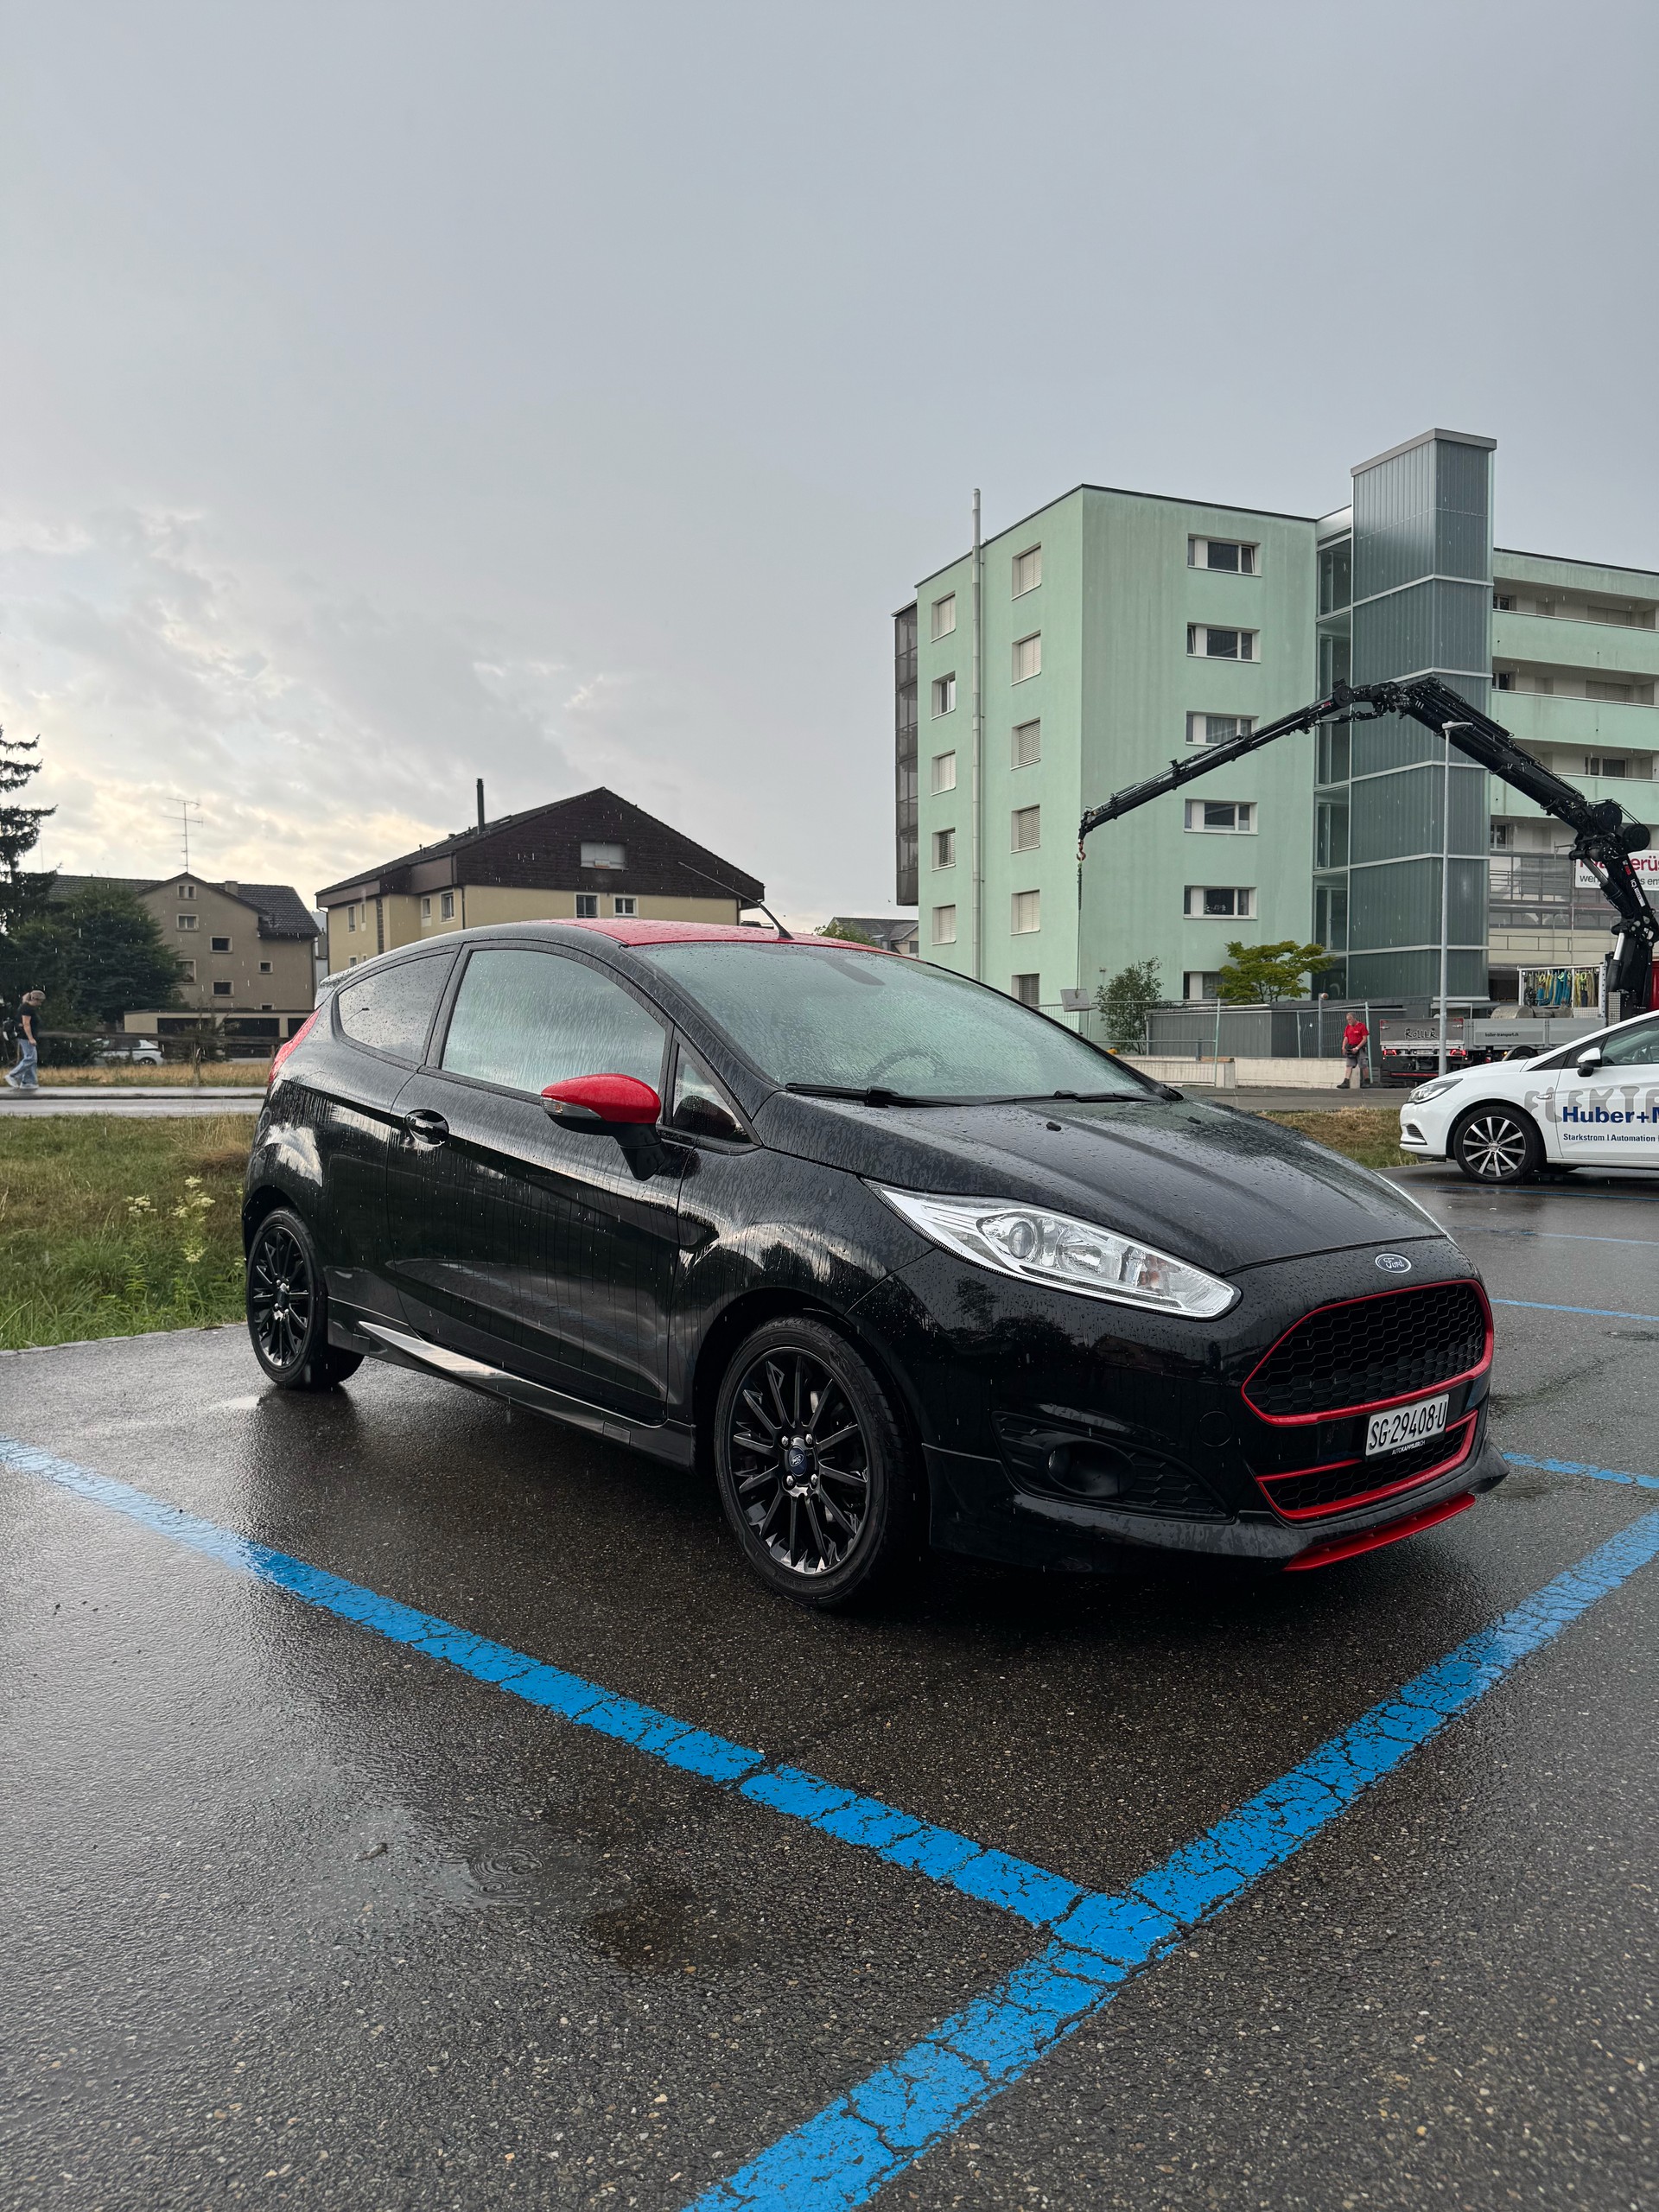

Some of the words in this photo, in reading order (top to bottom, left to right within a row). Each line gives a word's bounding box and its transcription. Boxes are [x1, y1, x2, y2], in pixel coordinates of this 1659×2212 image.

[1562, 1133, 1605, 1141] Starkstrom
[1611, 1134, 1656, 1142] Automation
[1382, 1257, 1405, 1269] Ford
